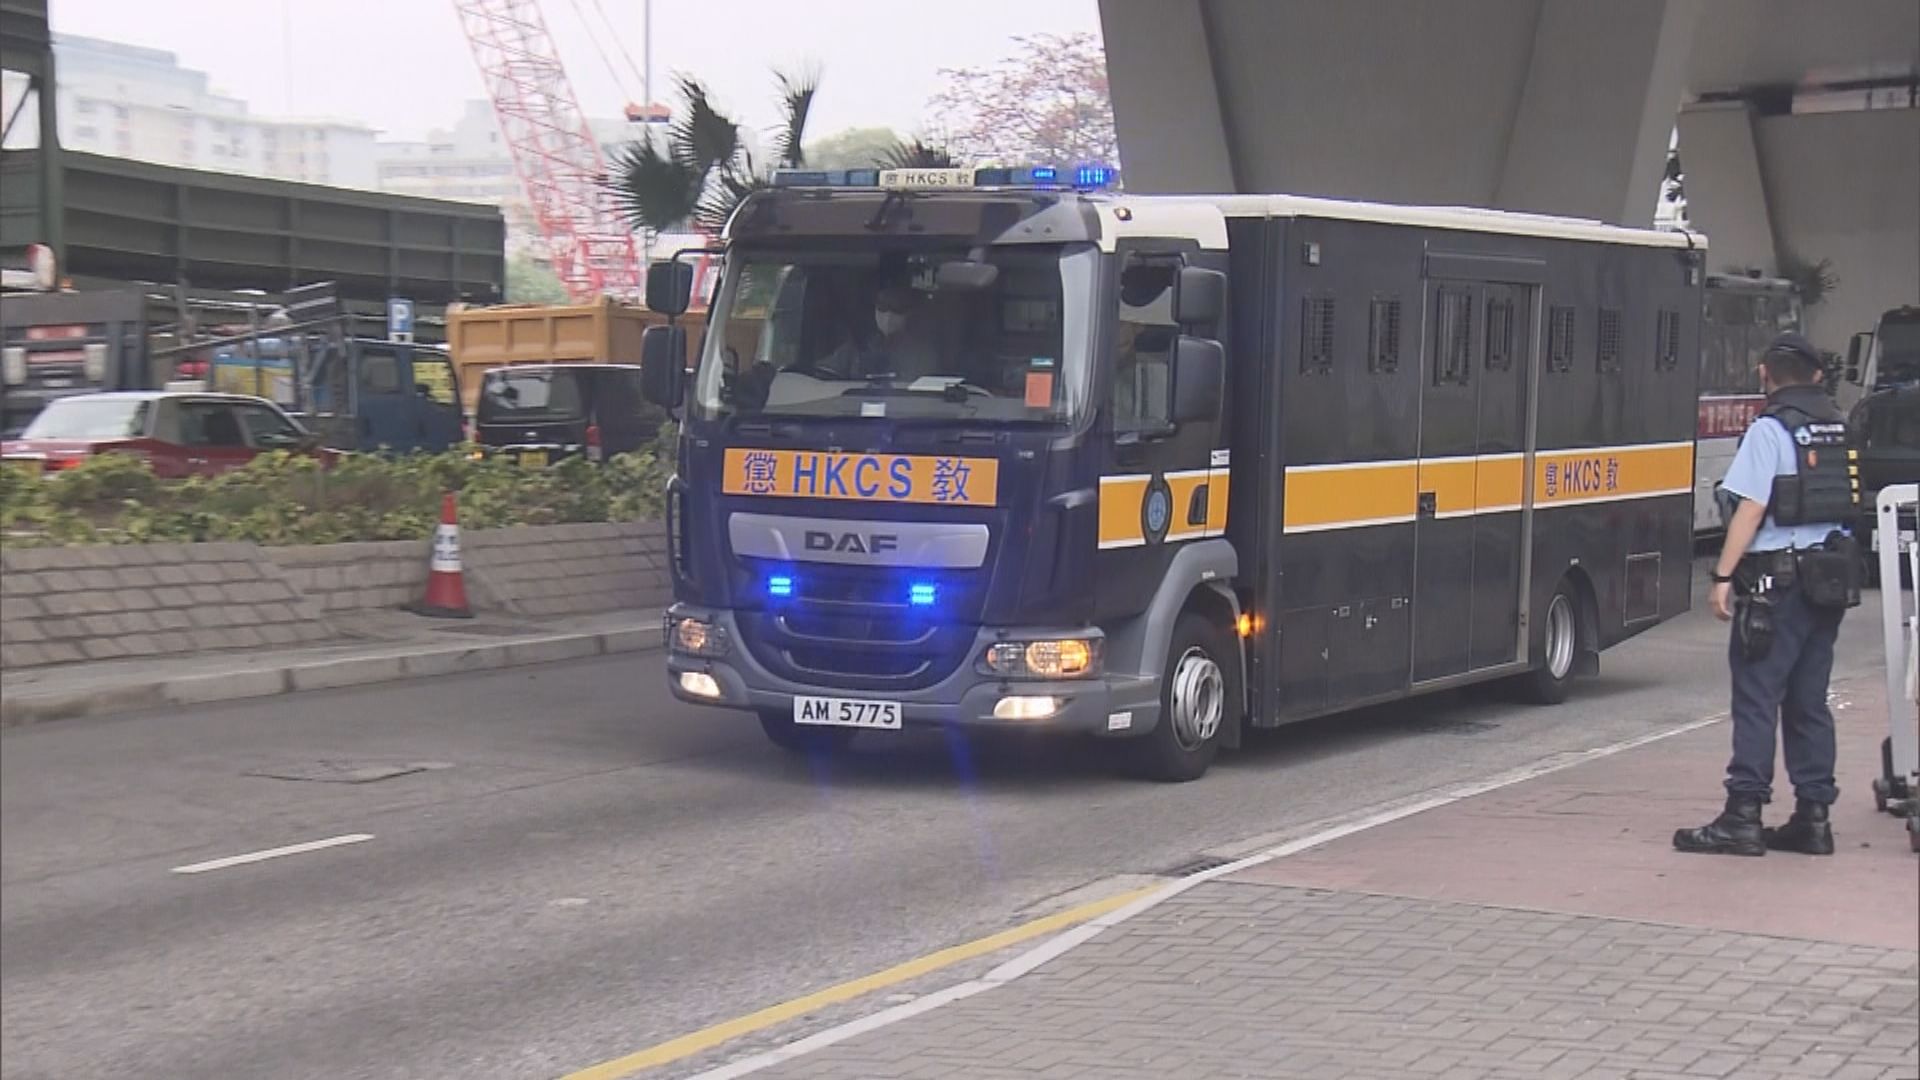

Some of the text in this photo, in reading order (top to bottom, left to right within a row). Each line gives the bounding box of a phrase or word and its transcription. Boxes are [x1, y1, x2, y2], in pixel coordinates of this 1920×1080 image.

[905, 171, 948, 185] HKCS
[391, 303, 409, 330] P
[744, 451, 778, 494] 懲
[793, 454, 913, 499] HKCS
[1563, 458, 1601, 494] HKCS
[805, 530, 898, 555] DAF
[801, 699, 896, 725] AM 5775
